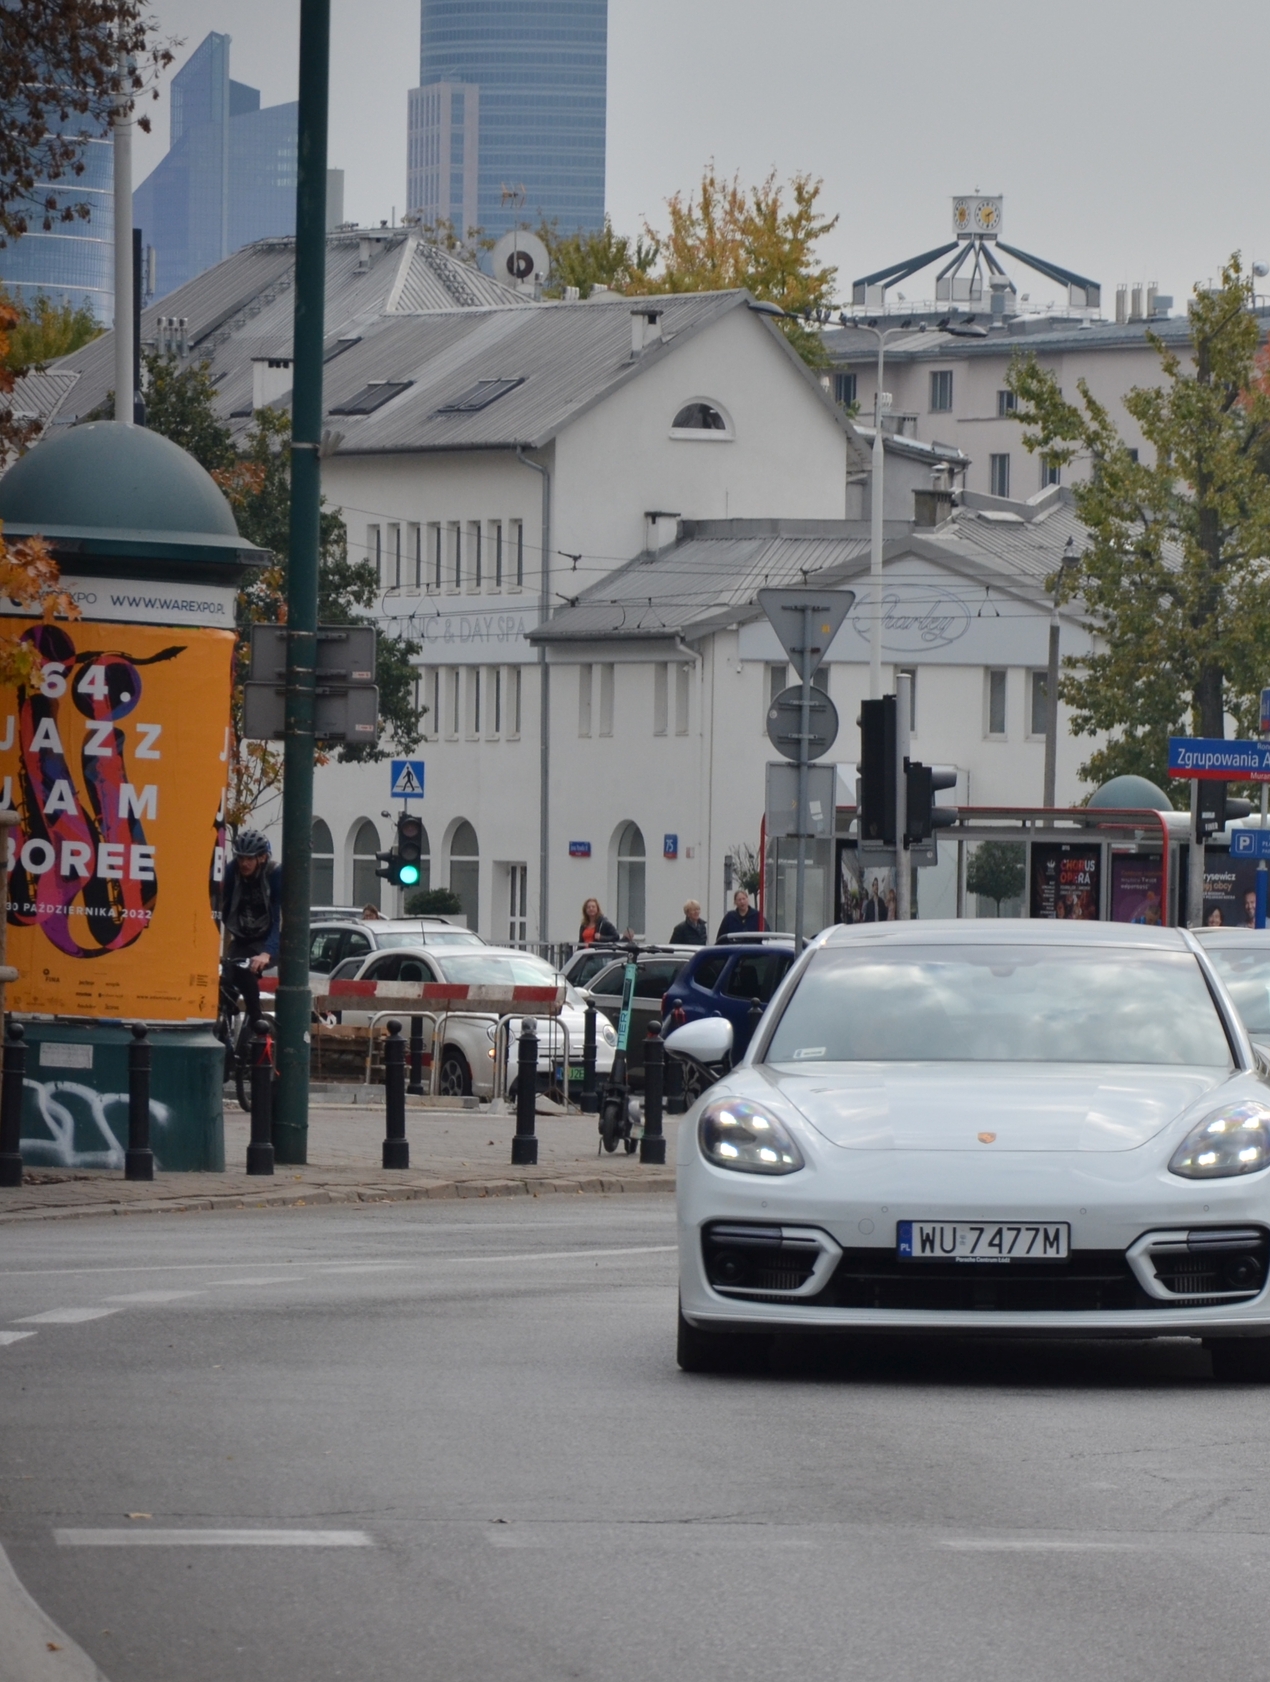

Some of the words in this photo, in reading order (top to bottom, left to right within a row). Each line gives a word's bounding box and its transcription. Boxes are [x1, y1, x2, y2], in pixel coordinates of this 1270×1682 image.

[110, 594, 226, 615] WWW.WAREXPO.PL
[443, 617, 456, 644] &
[459, 616, 494, 644] DAY
[497, 616, 526, 643] SPA
[39, 661, 131, 701] 64.
[0, 715, 162, 760] JAZZ
[1177, 748, 1259, 770] Zgrupowania
[0, 776, 158, 820] JAM
[665, 839, 674, 852] 75
[23, 902, 116, 917] PAŹDZIERNIKA
[121, 909, 152, 919] 2022
[617, 1012, 628, 1044] TIER
[900, 1243, 910, 1251] PL
[919, 1226, 957, 1254] WU
[969, 1227, 1060, 1255] 7477M
